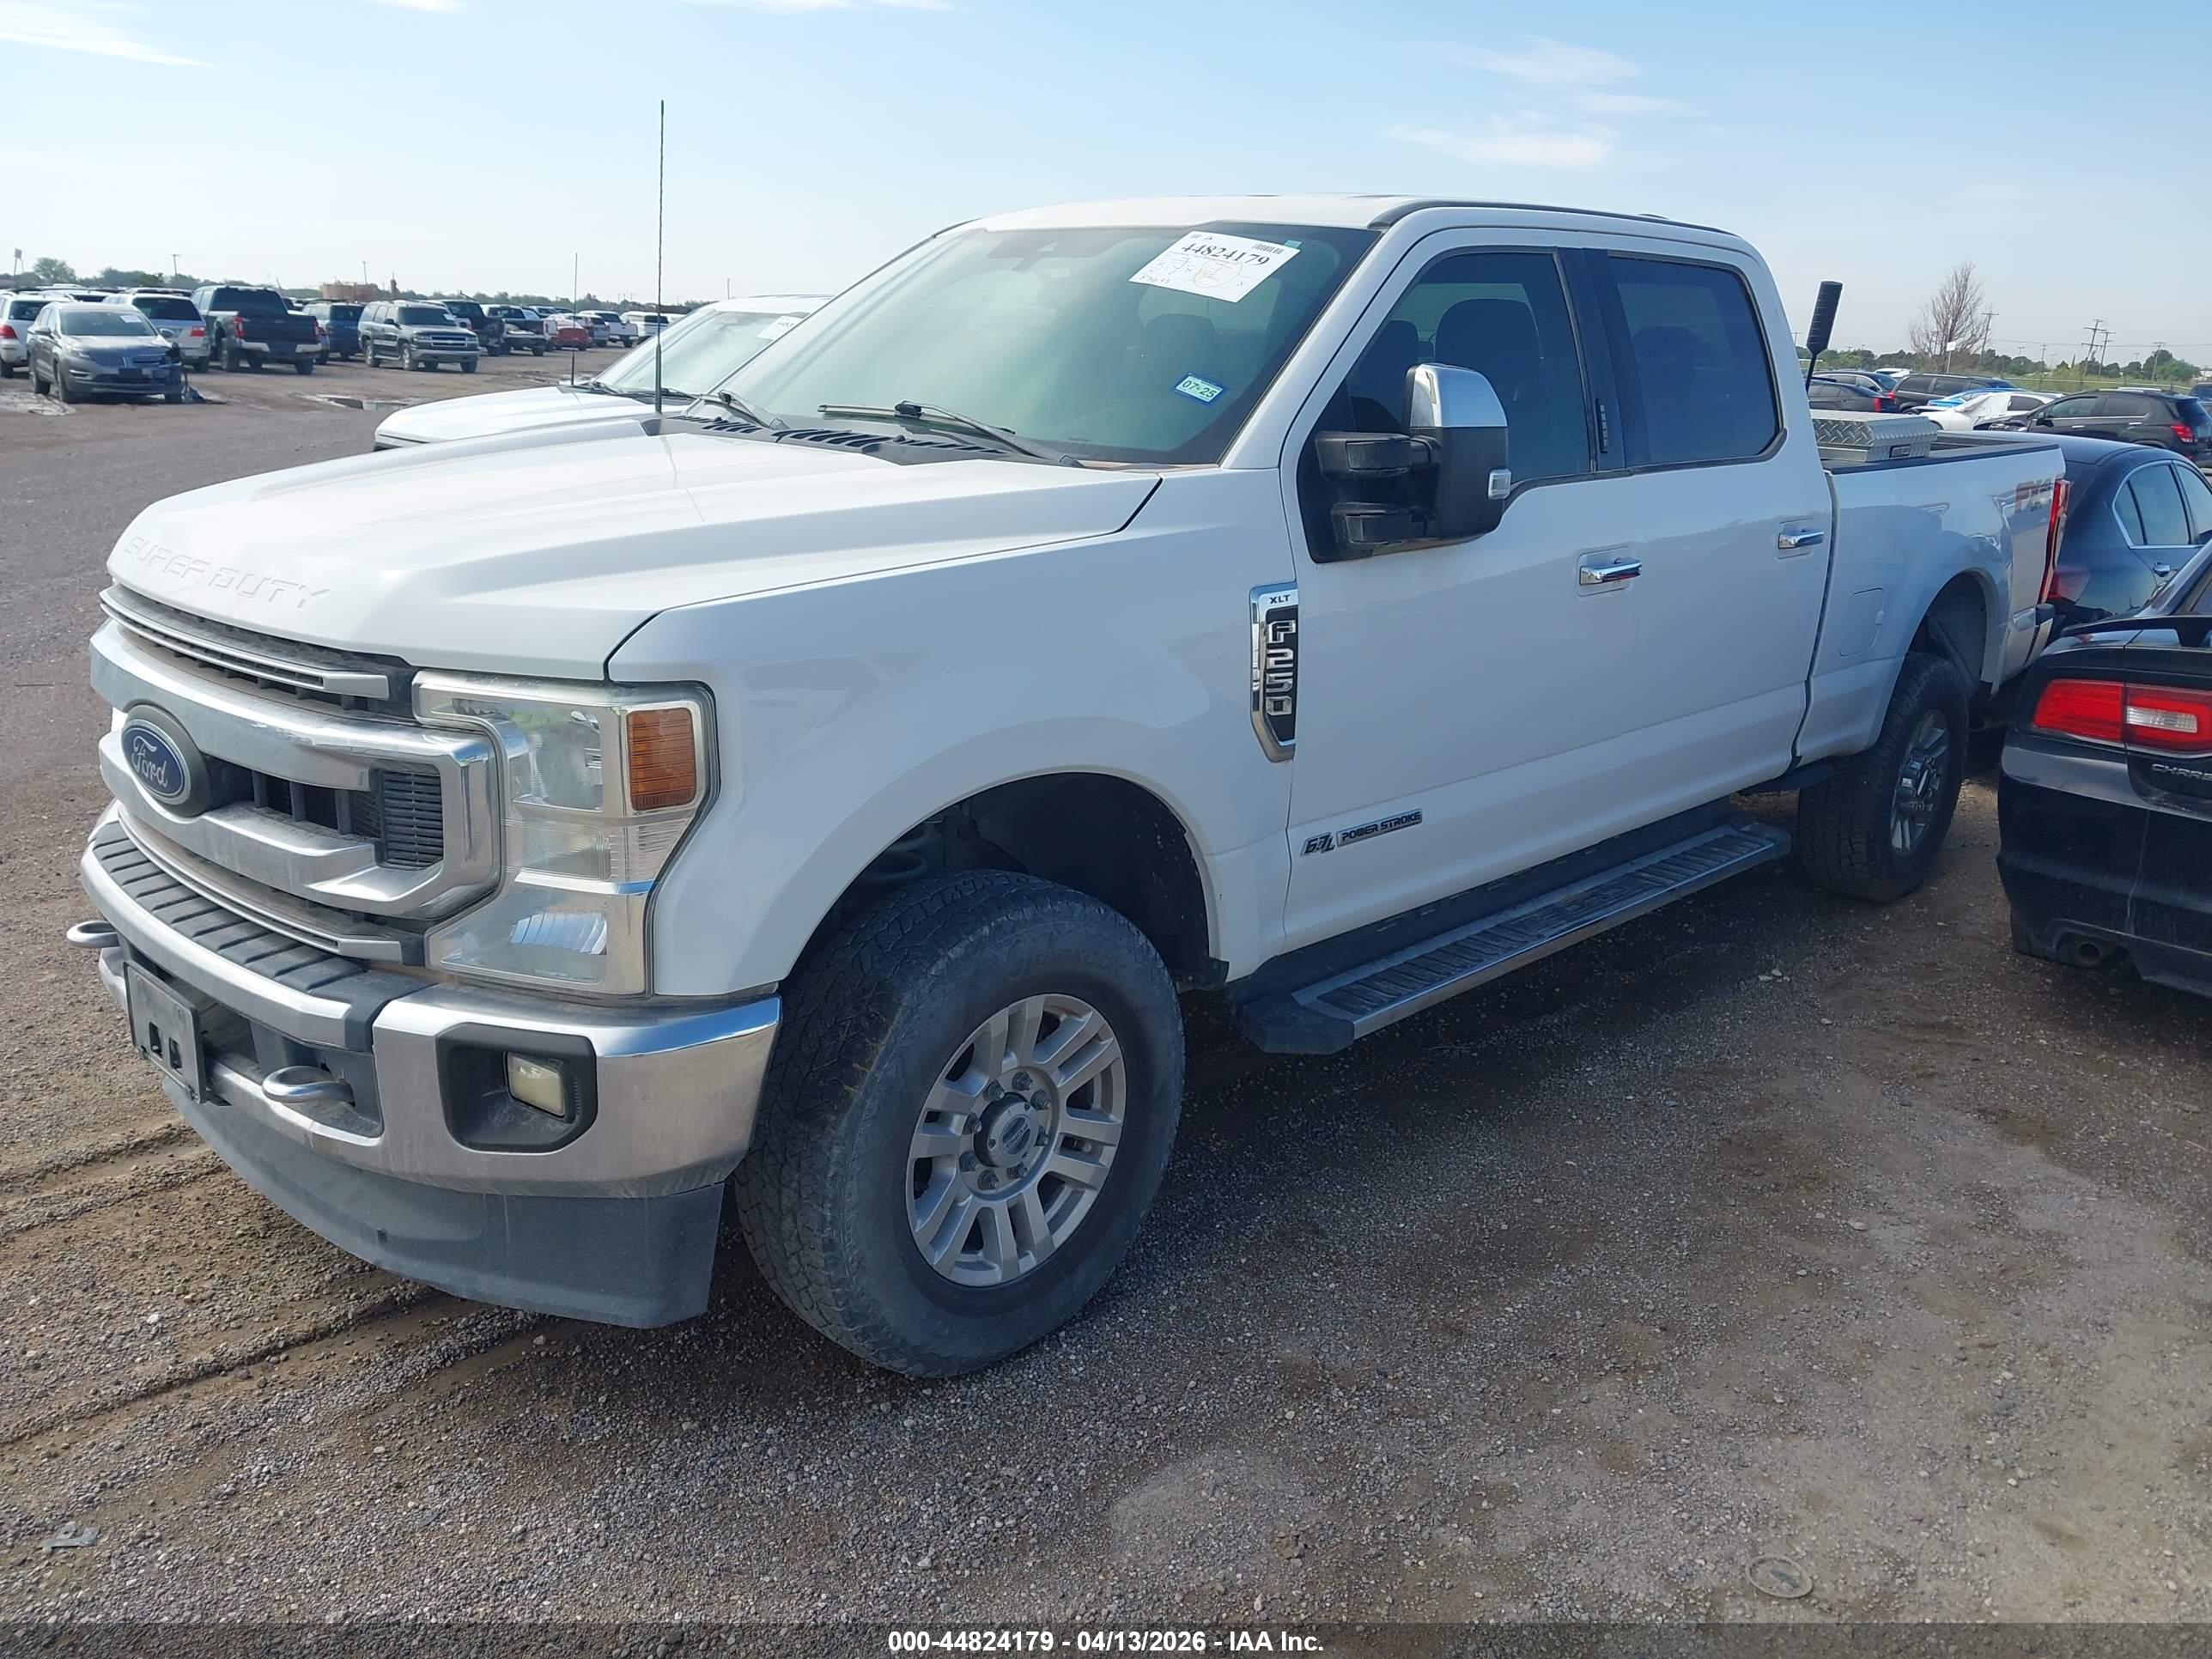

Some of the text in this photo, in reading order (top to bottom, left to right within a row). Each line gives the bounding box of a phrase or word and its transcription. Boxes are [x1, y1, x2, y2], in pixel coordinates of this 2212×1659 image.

[1181, 242, 1271, 267] 44824179
[124, 535, 331, 610] SUPER DUTY
[1269, 594, 1291, 605] XLT
[1266, 620, 1296, 715] F250
[131, 735, 168, 788] Ford
[1304, 811, 1422, 854] 6.7L POWER STROKE
